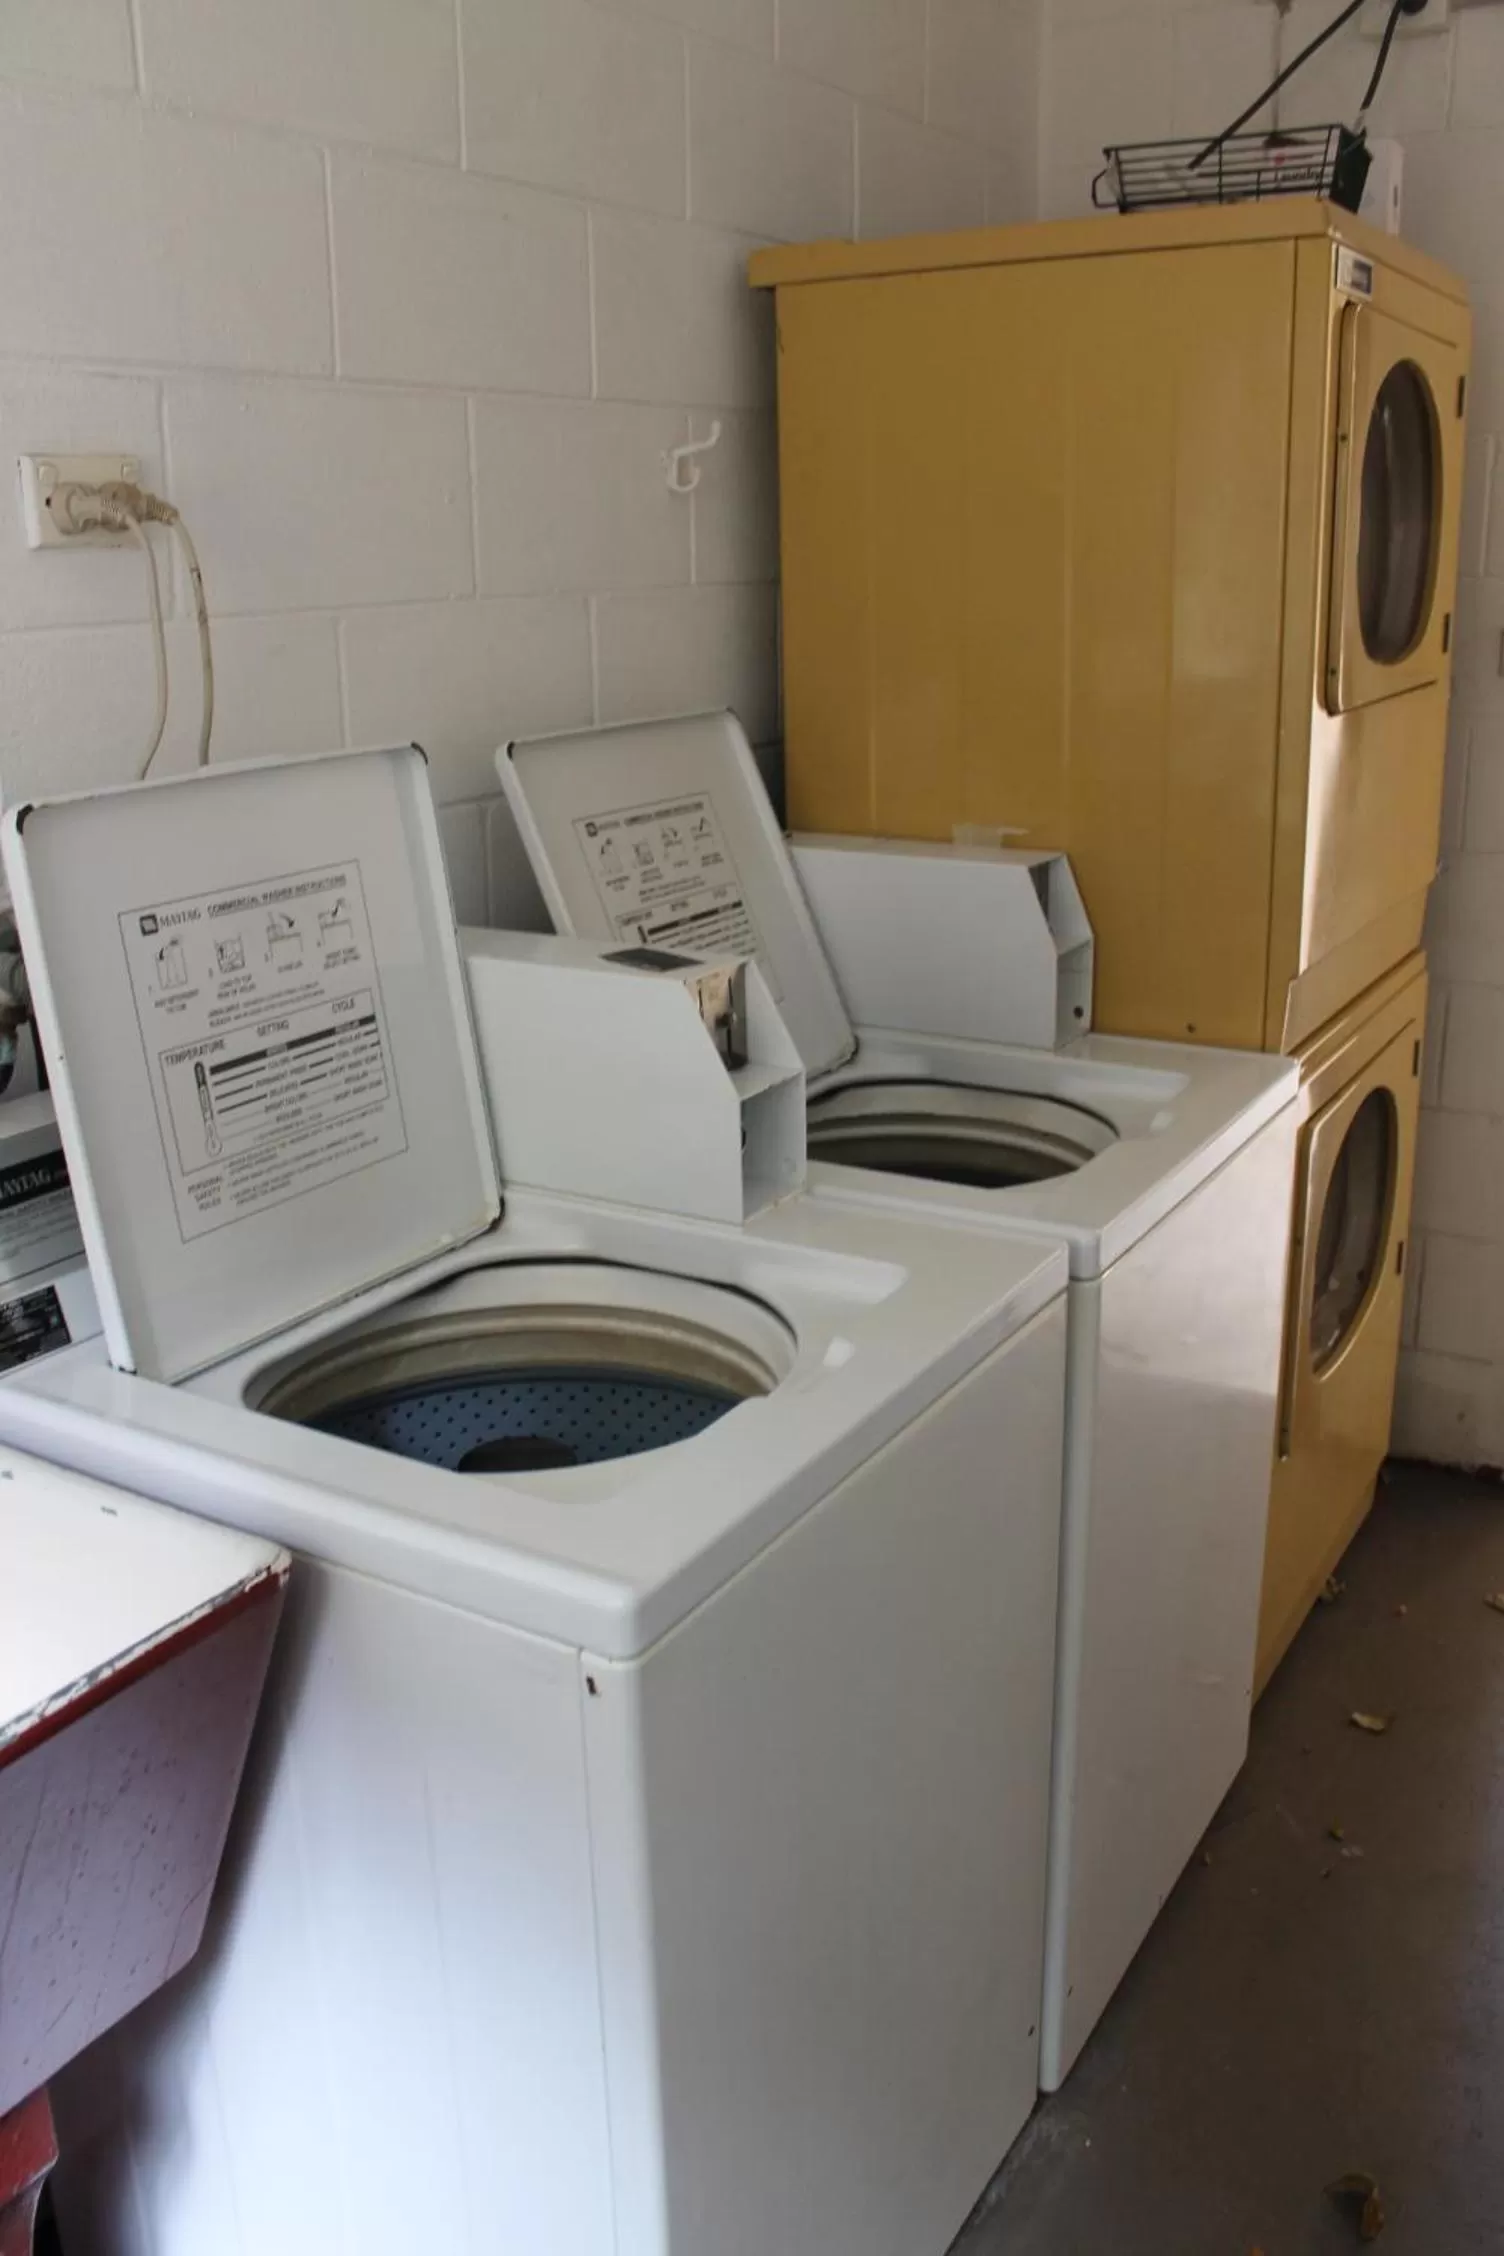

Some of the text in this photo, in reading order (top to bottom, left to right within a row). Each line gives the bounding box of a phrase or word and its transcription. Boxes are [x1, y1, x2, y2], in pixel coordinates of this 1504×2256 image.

[207, 895, 259, 918] COMMERCIAL
[159, 908, 201, 928] MAYTAG
[332, 998, 355, 1014] CYCLE
[256, 1020, 290, 1037] SETTING
[164, 1039, 225, 1067] TEMPERATURE
[0, 1169, 51, 1199] AYTAG
